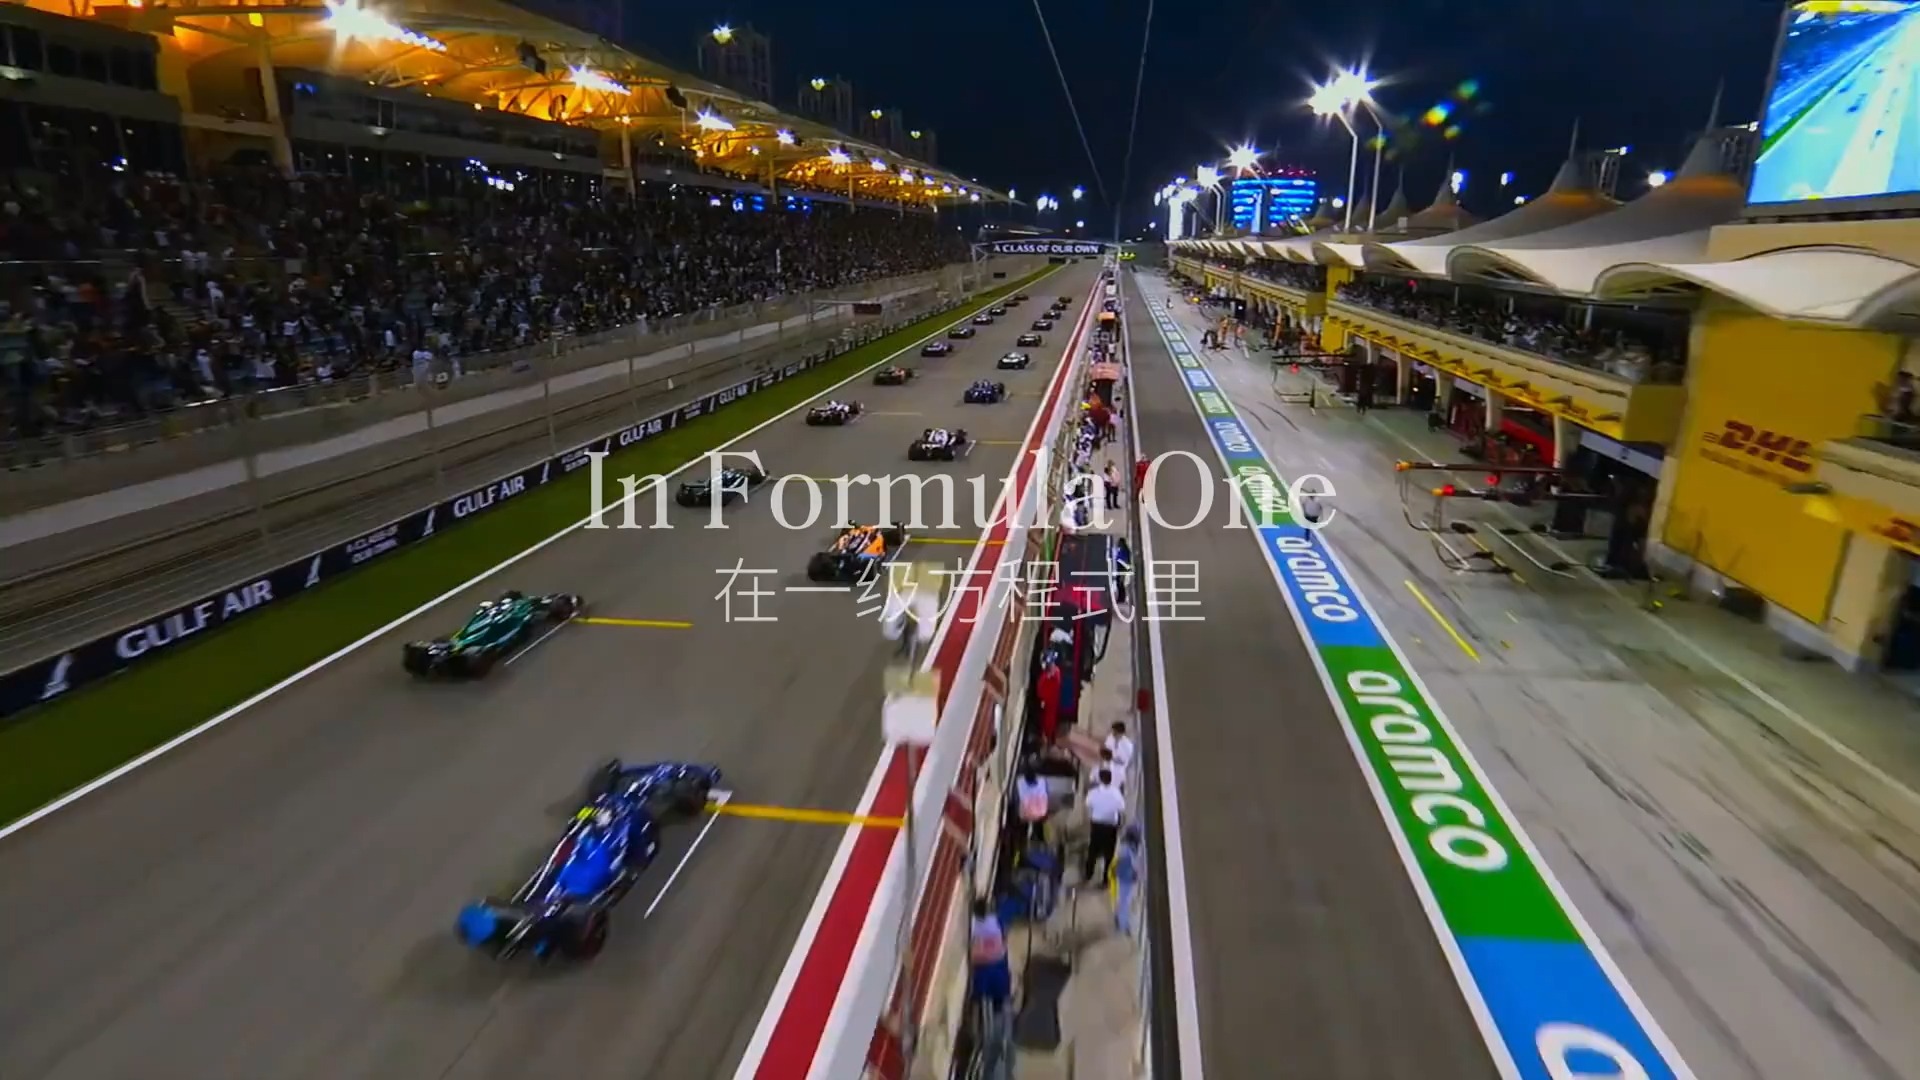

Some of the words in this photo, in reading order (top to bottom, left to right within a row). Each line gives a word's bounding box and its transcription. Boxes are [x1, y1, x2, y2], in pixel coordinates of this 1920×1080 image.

[993, 244, 1000, 253] A
[1002, 244, 1035, 253] CLASS
[1036, 244, 1049, 253] OF
[1051, 244, 1073, 253] OUR
[1074, 244, 1099, 253] OWN
[620, 426, 645, 446] GULF
[646, 418, 663, 434] AIR
[453, 485, 498, 518] GULF
[500, 475, 525, 499] AIR
[1276, 536, 1359, 622] aramco
[116, 600, 215, 659] GULF
[222, 579, 273, 621] AIR
[1346, 671, 1509, 872] aramco
